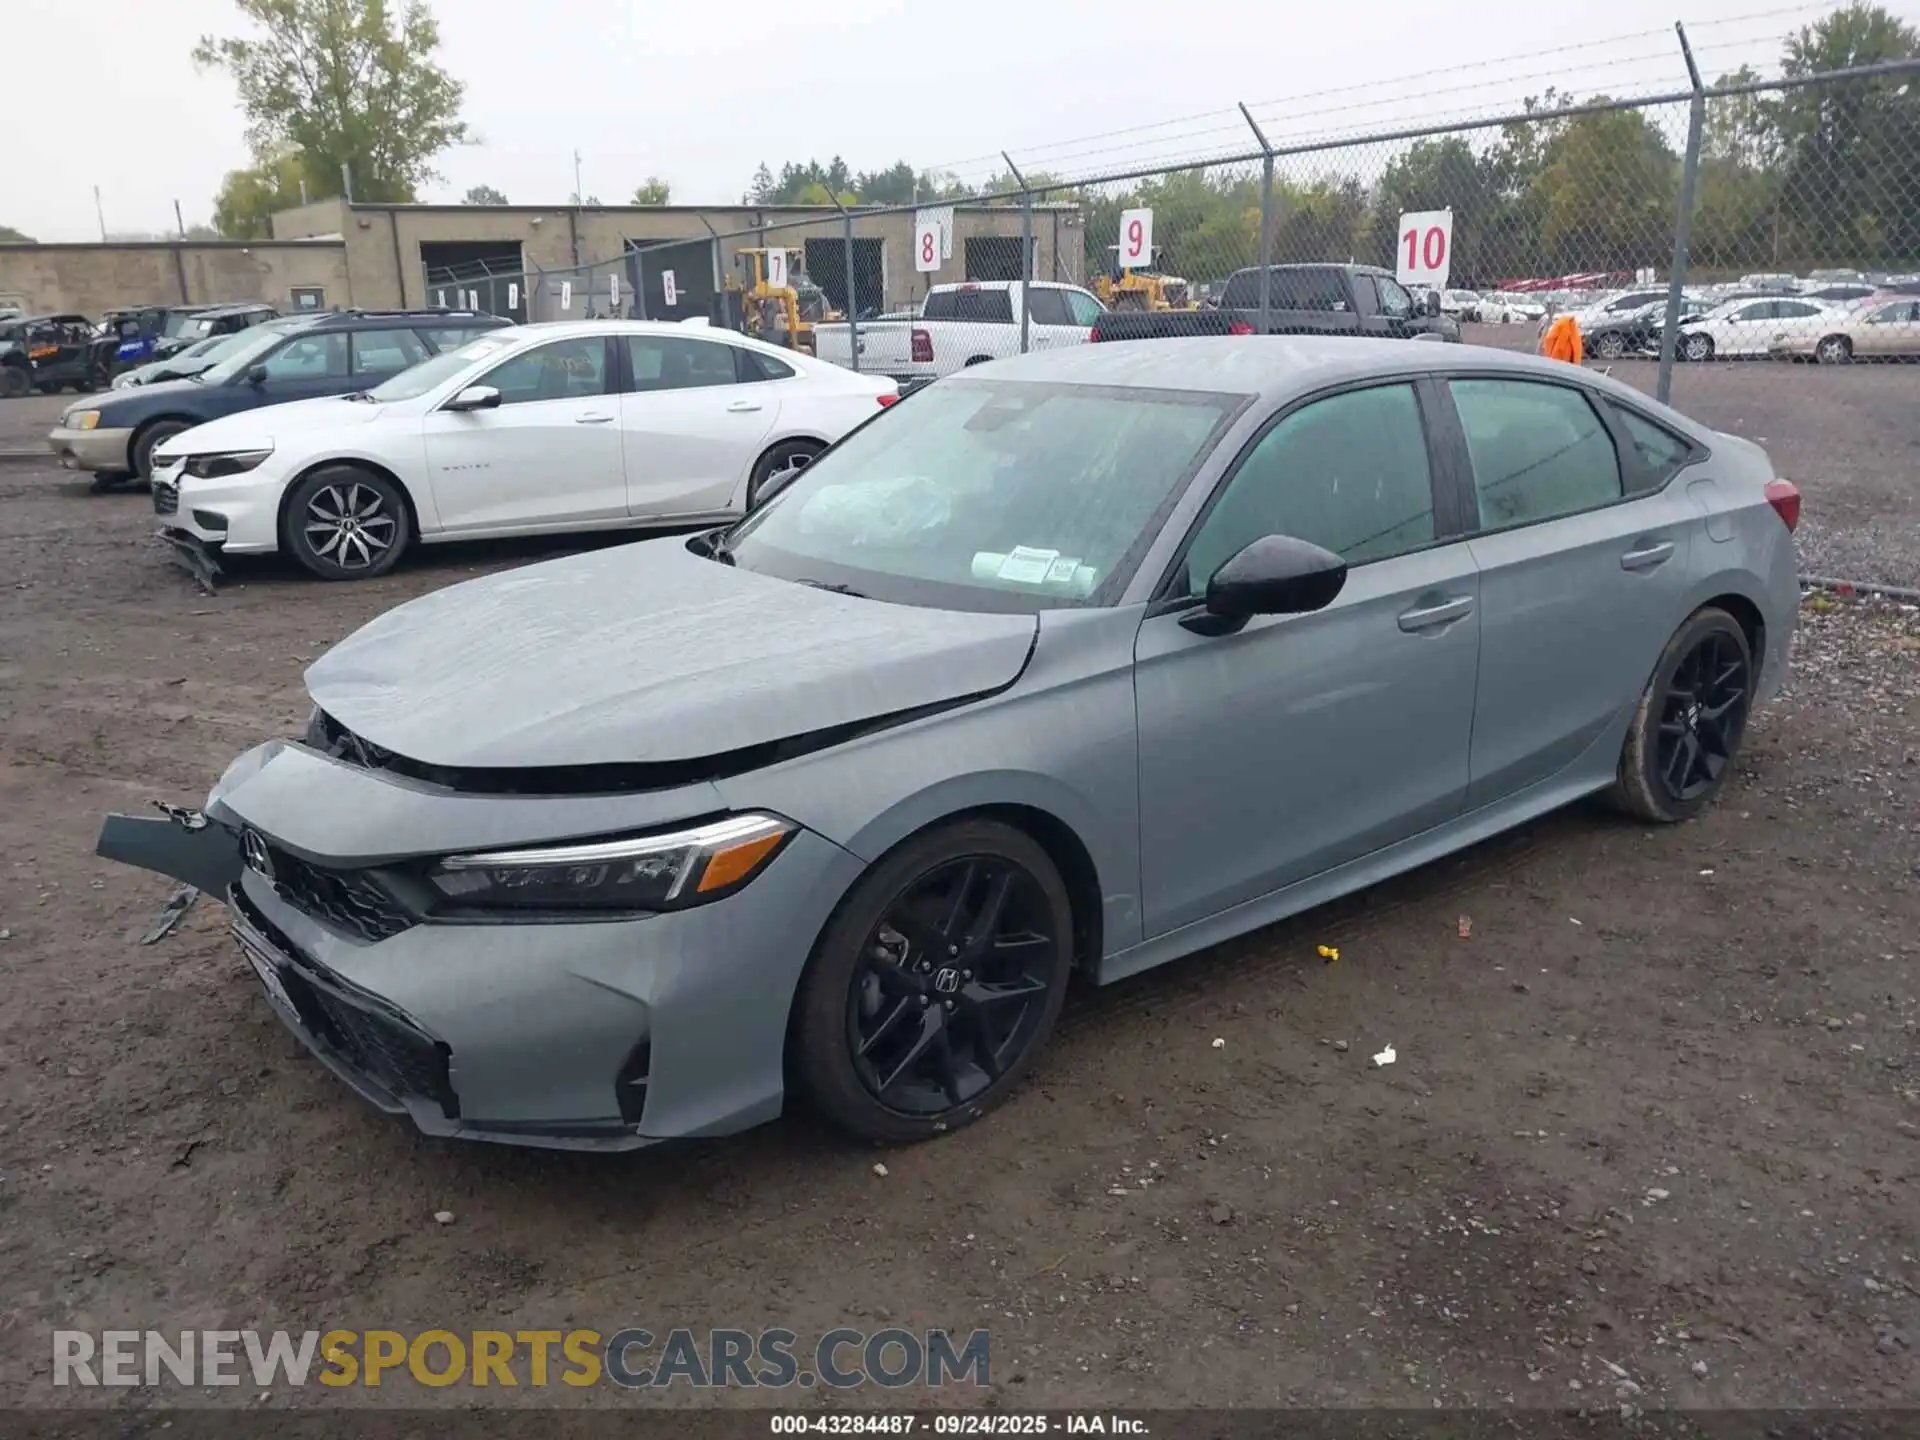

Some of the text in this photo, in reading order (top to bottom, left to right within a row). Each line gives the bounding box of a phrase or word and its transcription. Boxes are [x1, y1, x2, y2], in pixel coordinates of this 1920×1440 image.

[922, 232, 933, 263] 8
[1128, 219, 1142, 256] 9
[1403, 226, 1445, 270] 10
[772, 255, 781, 282] 7
